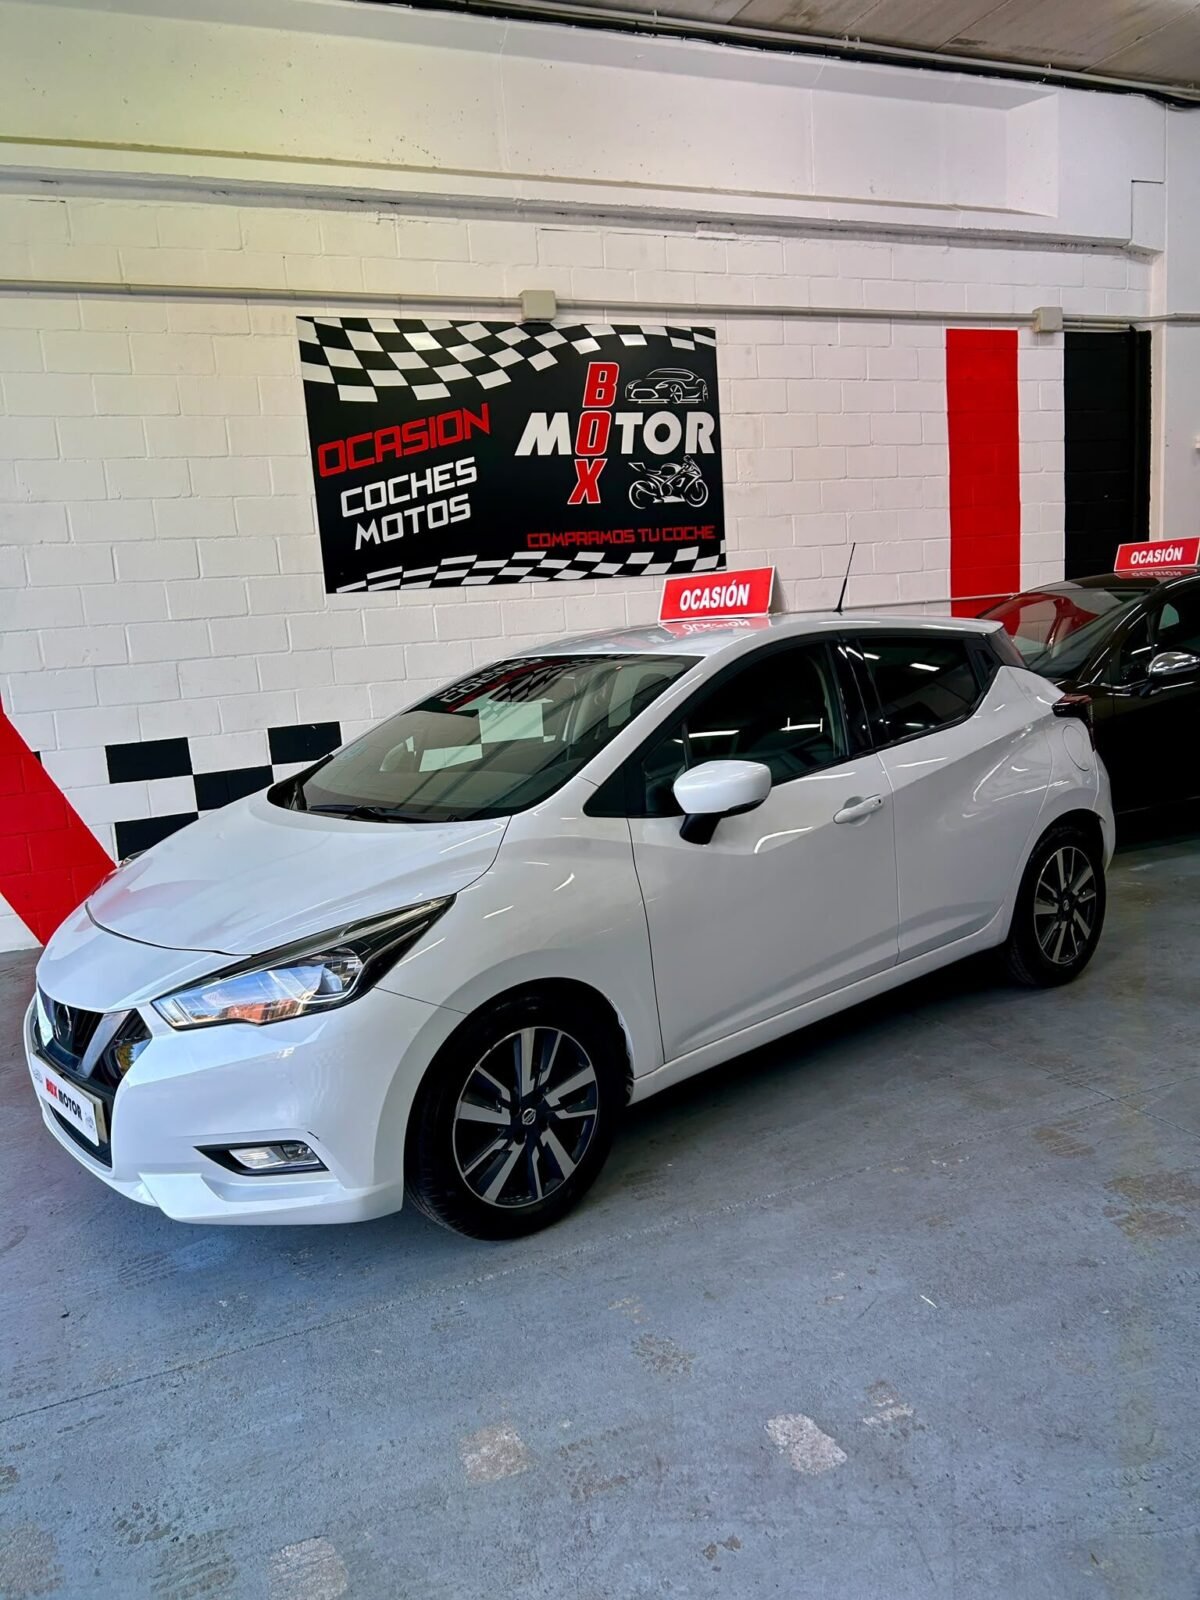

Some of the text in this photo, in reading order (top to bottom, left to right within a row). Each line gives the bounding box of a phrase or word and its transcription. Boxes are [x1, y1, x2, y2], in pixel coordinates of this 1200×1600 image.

[317, 402, 491, 478] OCASION
[567, 361, 620, 505] BOX
[340, 456, 478, 518] COCHES
[354, 493, 472, 551] MOTOS
[526, 525, 717, 549] COMPRAMOS TU COCHE
[1130, 545, 1184, 565] OCASIÓN
[680, 580, 750, 612] OCASIÓN
[58, 1088, 83, 1121] MOTOR
